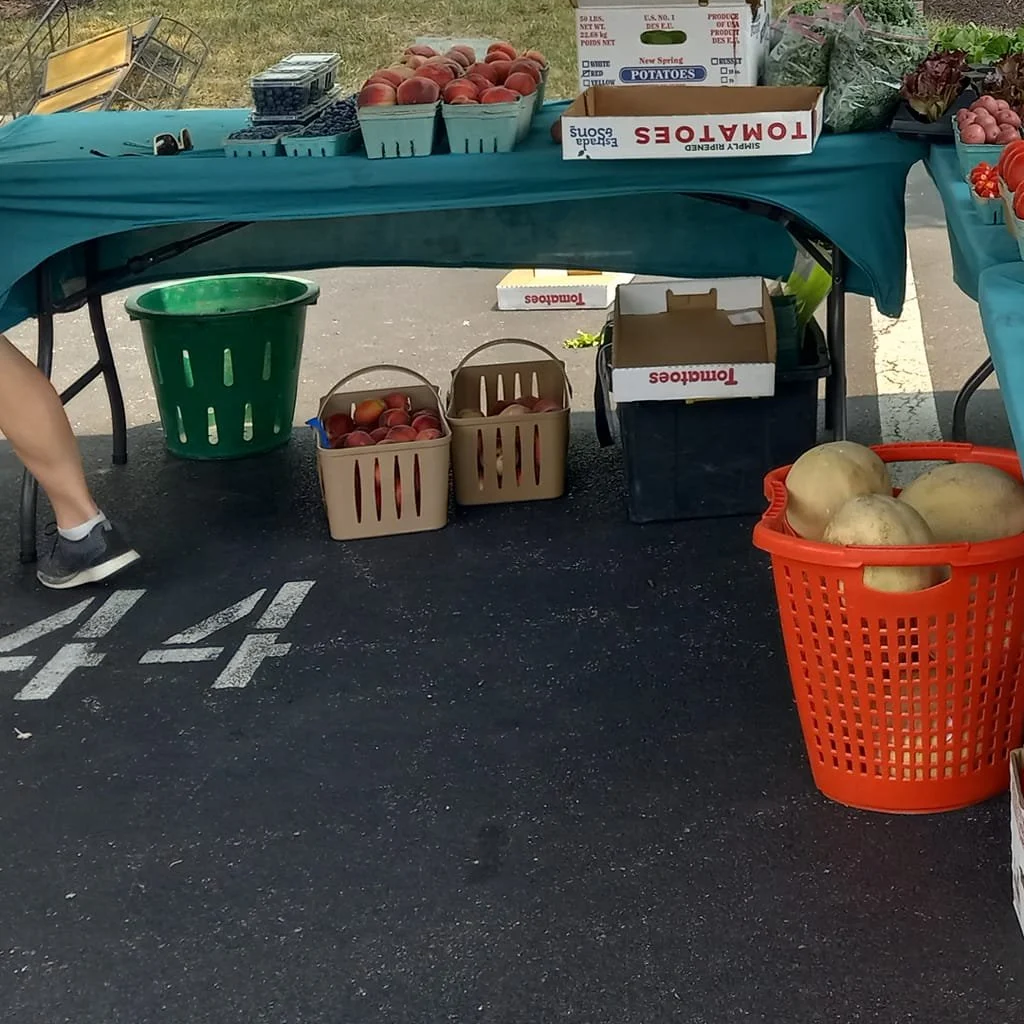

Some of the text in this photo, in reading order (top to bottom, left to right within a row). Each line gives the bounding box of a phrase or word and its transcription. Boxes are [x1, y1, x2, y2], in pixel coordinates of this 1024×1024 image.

[599, 31, 608, 39] kg
[590, 60, 611, 68] WHITE
[657, 56, 684, 65] Spring
[630, 69, 696, 80] POTATOES
[634, 121, 807, 145] TOMATOES
[575, 136, 618, 150] Estrada
[684, 142, 761, 152] SIMPLY RIPENED
[524, 292, 586, 306] Tomatoes
[649, 367, 738, 386] Tomatoes
